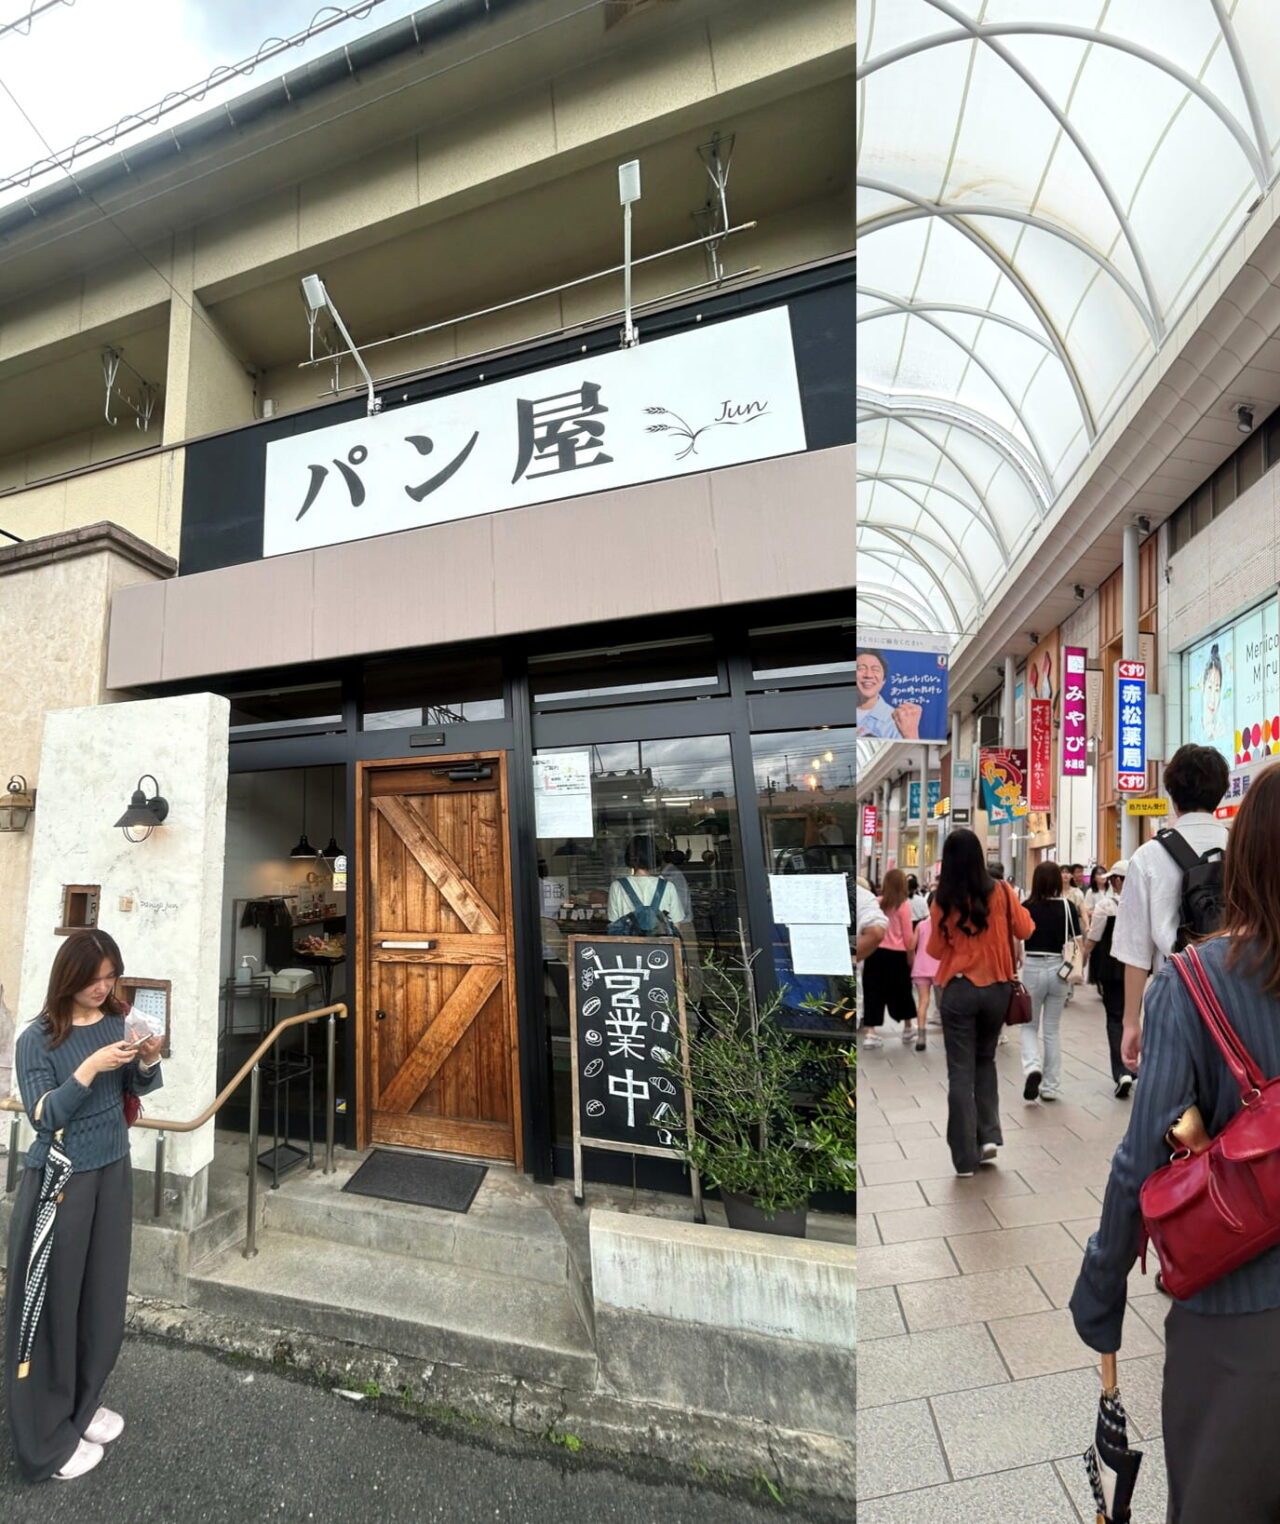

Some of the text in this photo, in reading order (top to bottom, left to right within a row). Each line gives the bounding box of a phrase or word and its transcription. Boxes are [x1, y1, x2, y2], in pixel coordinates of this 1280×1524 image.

[713, 399, 768, 423] Jun
[296, 381, 614, 522] パン屋
[1119, 663, 1145, 676] くすり
[1065, 685, 1085, 752] みやび
[1122, 684, 1142, 768] 赤松薬局
[1118, 775, 1145, 788] くすり
[863, 808, 876, 835] JINS
[593, 954, 651, 1128] 営業中
